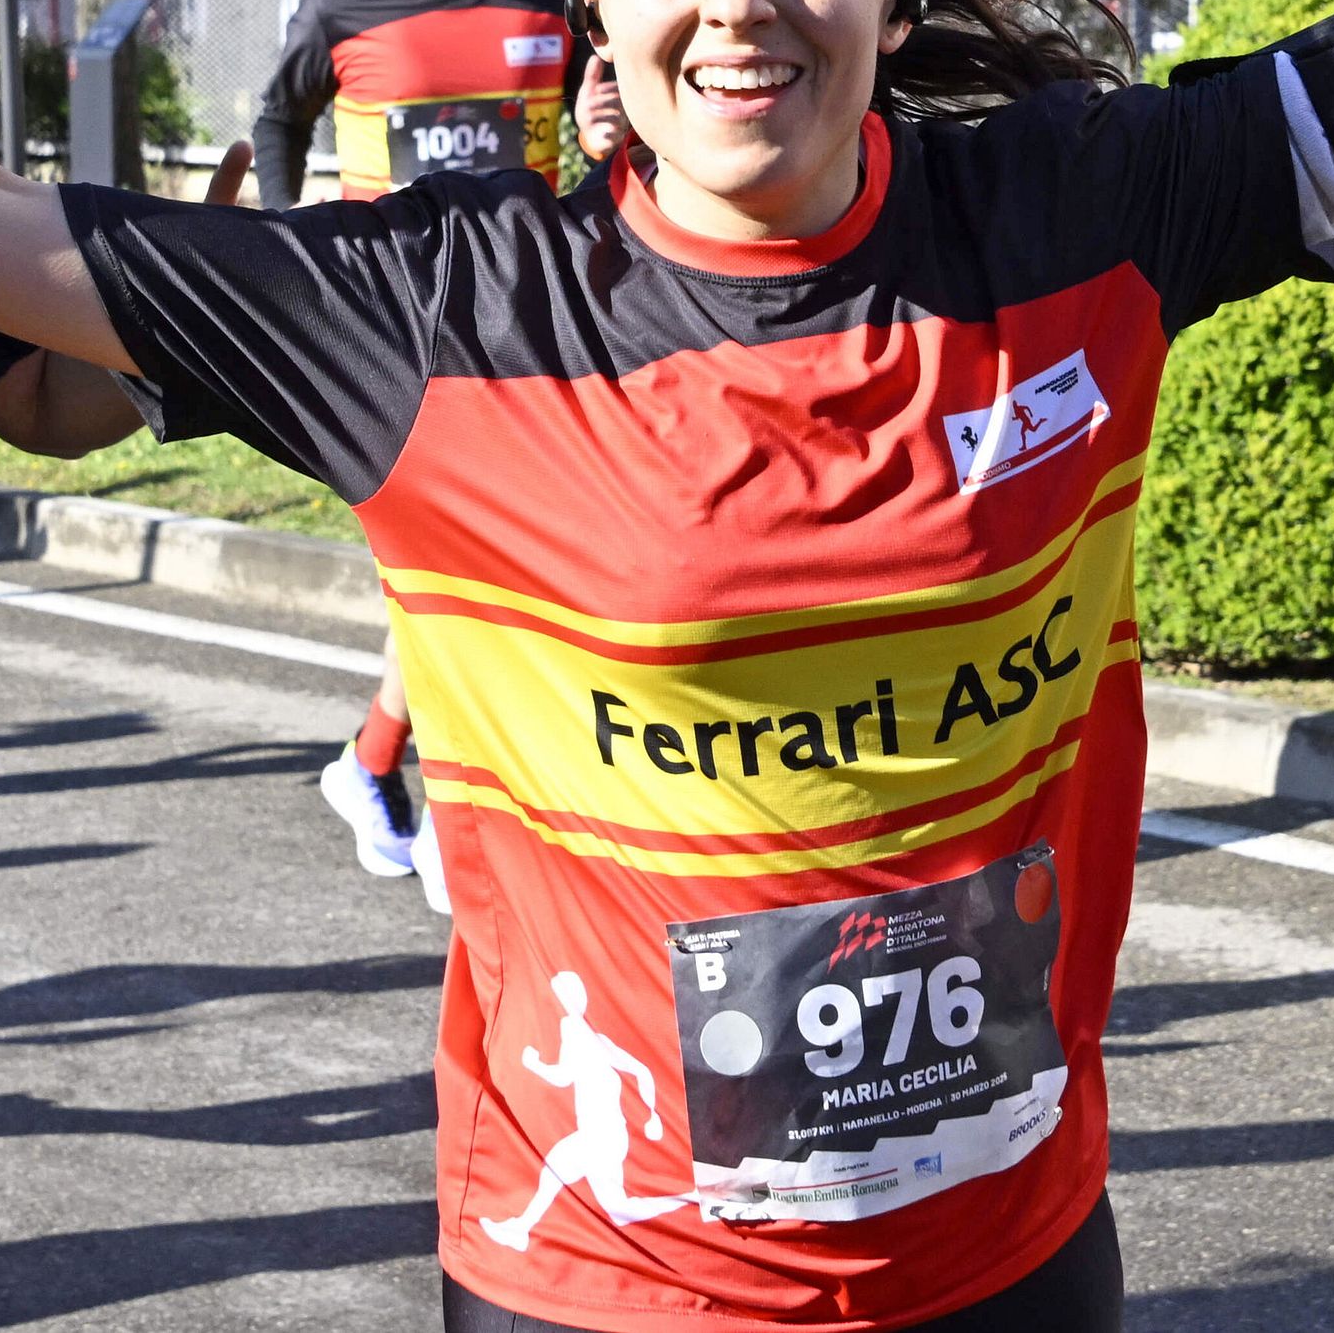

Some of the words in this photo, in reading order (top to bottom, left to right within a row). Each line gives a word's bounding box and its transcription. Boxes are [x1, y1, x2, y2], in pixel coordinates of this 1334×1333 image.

[412, 122, 500, 162] 1004
[590, 679, 900, 781] Ferrari
[933, 595, 1082, 745] ASC
[887, 914, 946, 936] MARATONA
[888, 909, 923, 925] MEZZA
[886, 930, 927, 947] D'ITALIA
[695, 953, 727, 992] B
[797, 955, 985, 1078] 976
[822, 1078, 896, 1111] MARIA
[899, 1054, 978, 1094] CECILIA
[818, 1124, 834, 1136] KM
[842, 1109, 900, 1131] MARANELLO
[906, 1097, 943, 1116] MODENA
[950, 1090, 962, 1103] 30
[962, 1080, 990, 1099] MARZO
[1009, 1106, 1047, 1142] BROOKS
